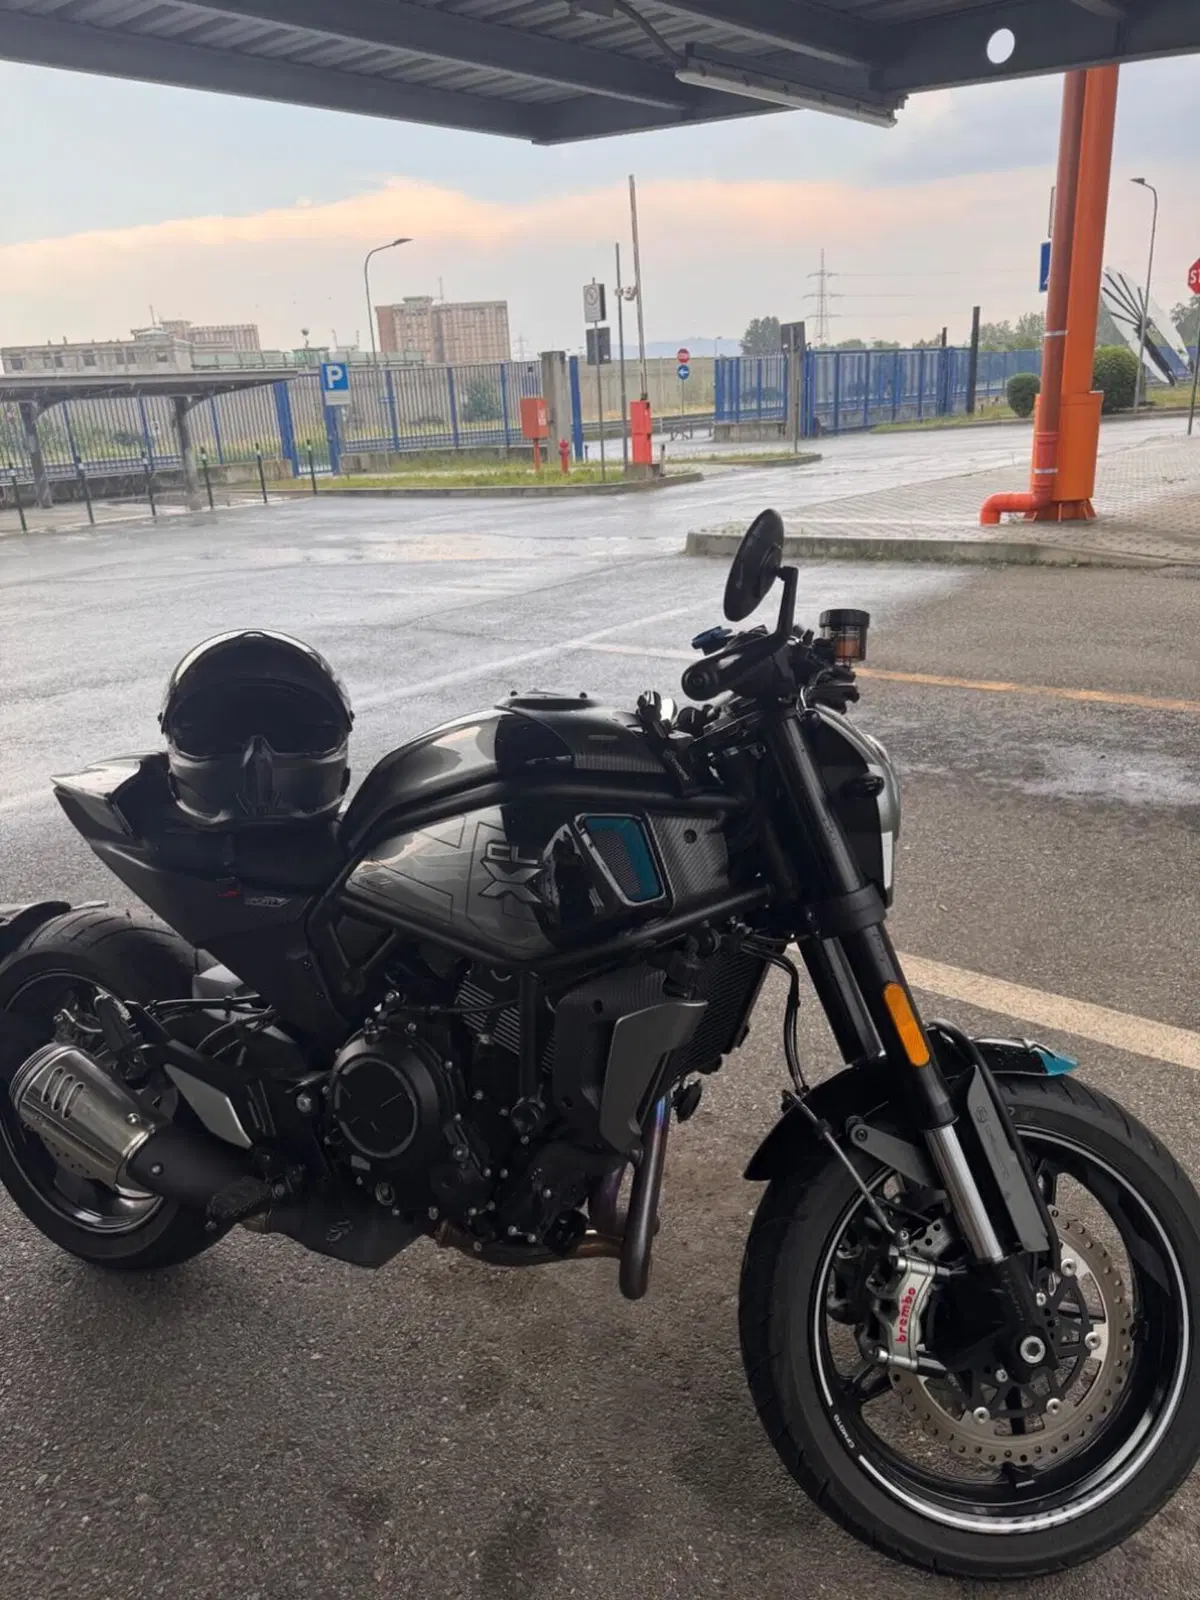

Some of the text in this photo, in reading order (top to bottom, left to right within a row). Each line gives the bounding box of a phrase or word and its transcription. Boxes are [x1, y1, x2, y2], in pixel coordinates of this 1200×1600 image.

[1190, 268, 1200, 284] S
[326, 365, 343, 389] P
[896, 1287, 916, 1343] brembo
